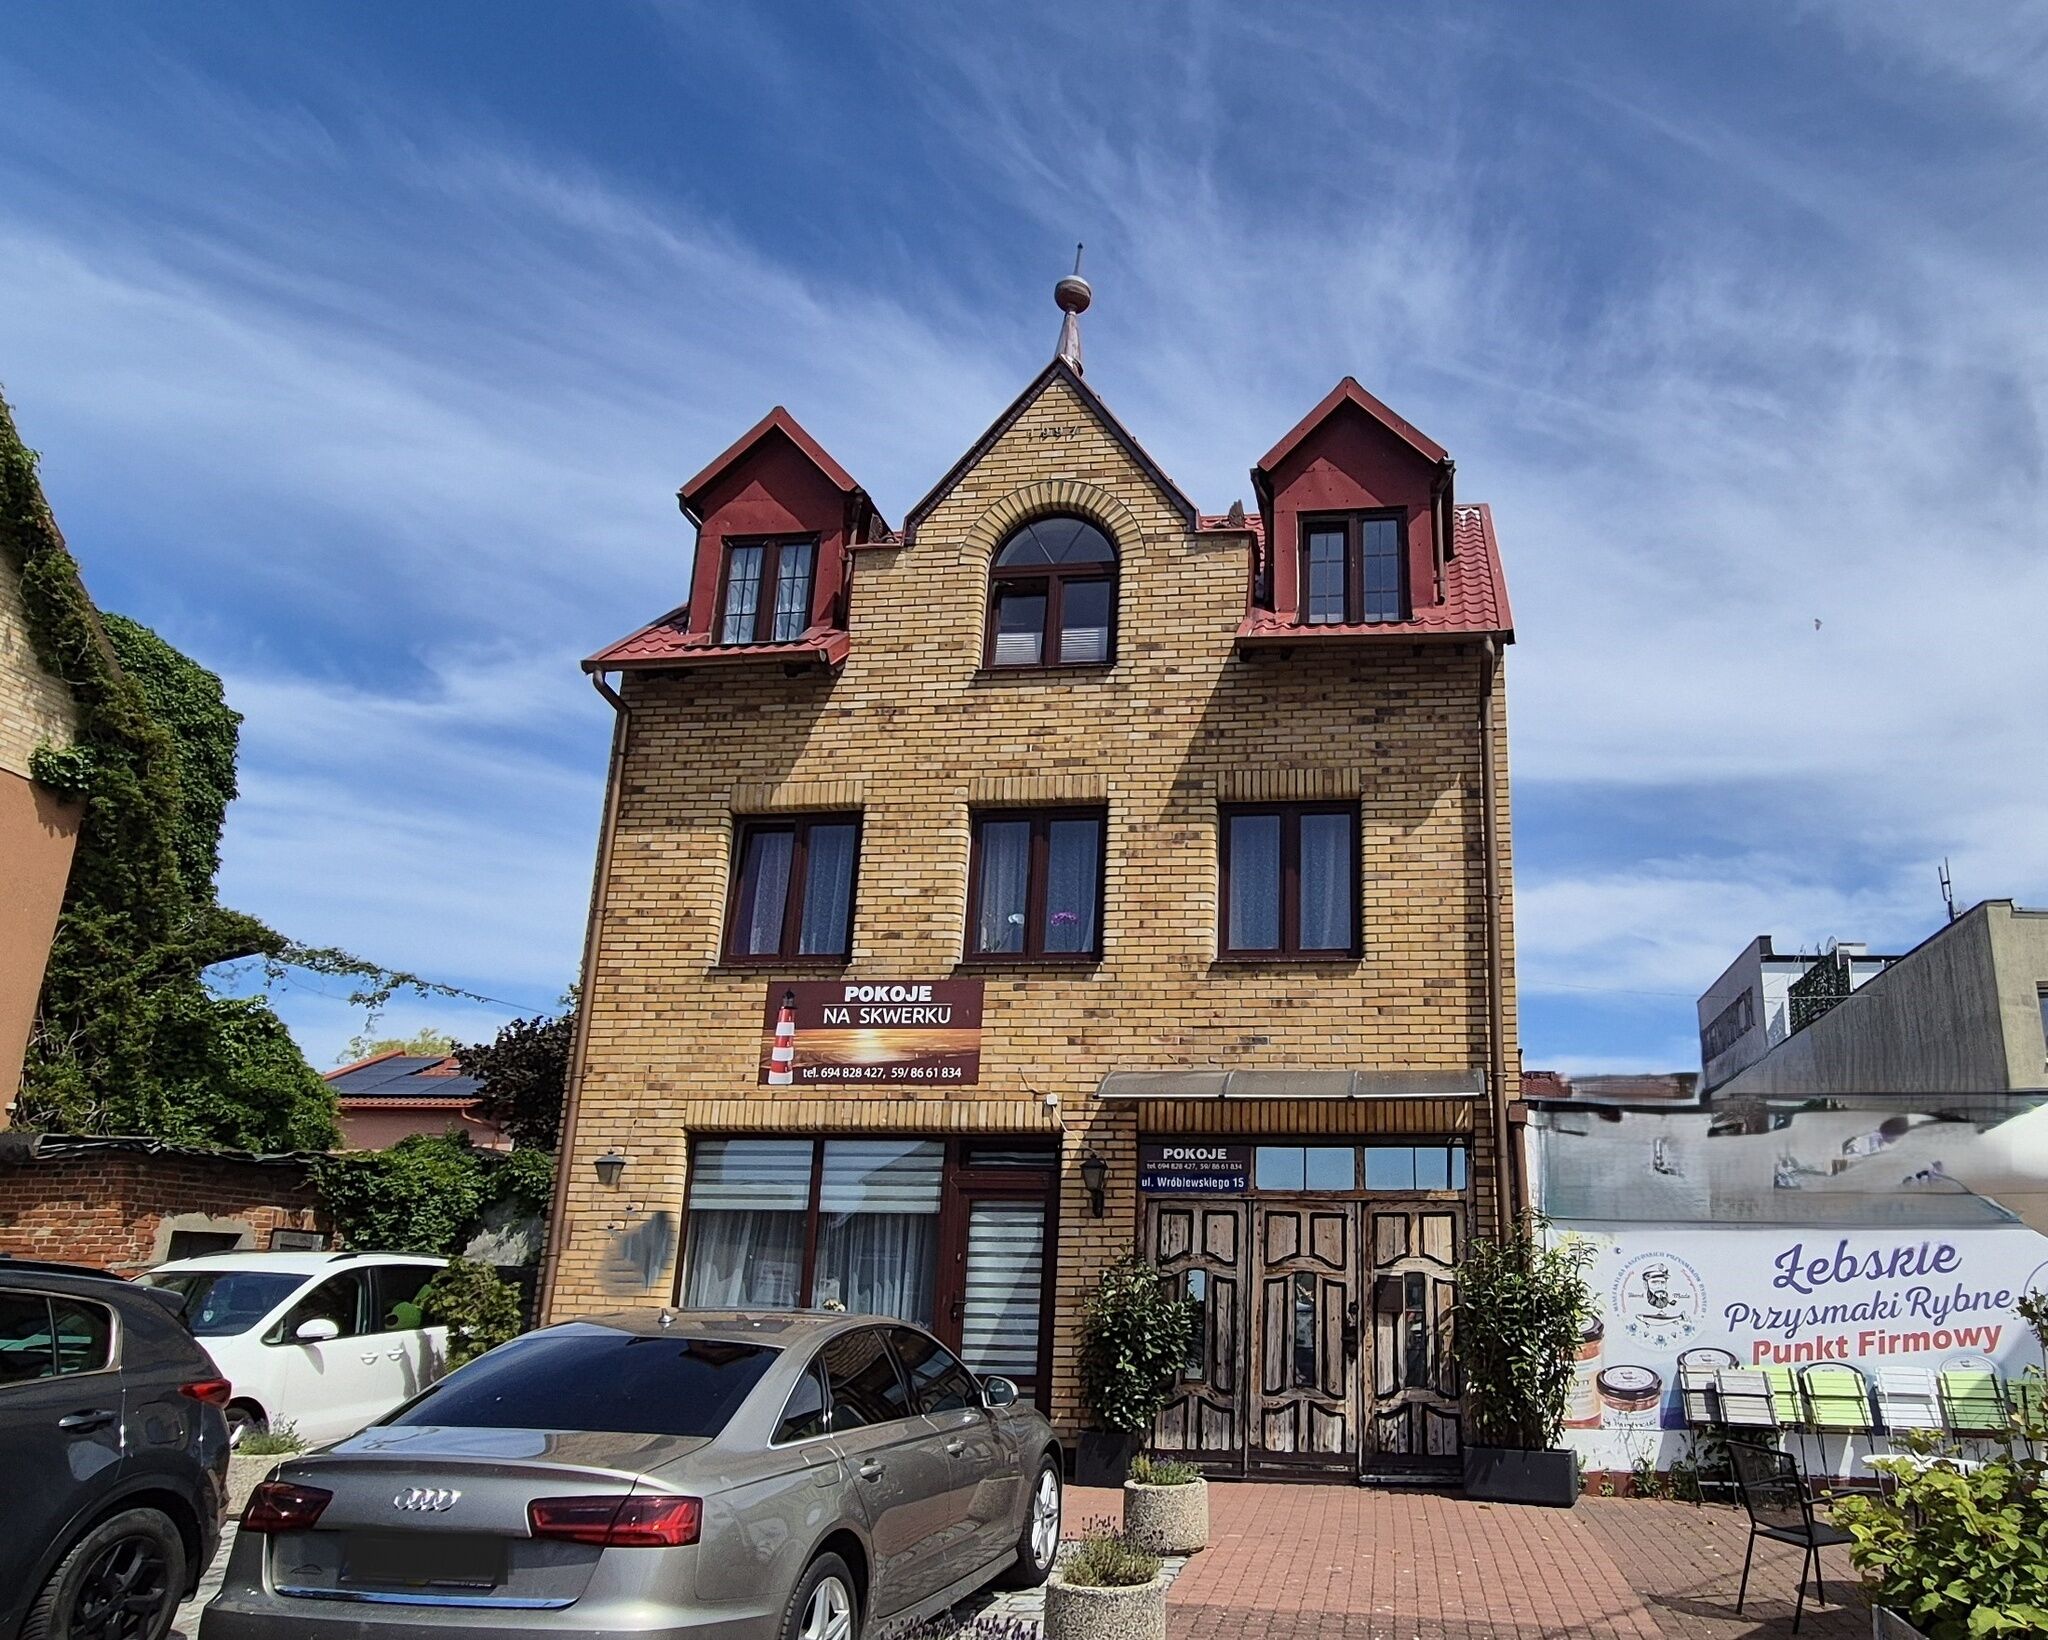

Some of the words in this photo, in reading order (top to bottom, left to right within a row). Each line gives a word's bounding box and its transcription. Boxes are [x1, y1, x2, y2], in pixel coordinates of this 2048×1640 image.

[845, 986, 932, 1002] POKOJE
[823, 1007, 850, 1024] NA
[859, 1007, 951, 1024] SKWERKU
[803, 1067, 819, 1078] tel.
[821, 1067, 840, 1078] 694
[843, 1067, 862, 1078] 828
[864, 1067, 886, 1079] 427,
[891, 1067, 909, 1078] 59/
[910, 1067, 924, 1078] 86
[926, 1067, 938, 1078] 61
[941, 1067, 961, 1078] 834
[1163, 1148, 1227, 1160] POKOJE
[1141, 1177, 1154, 1187] ul.
[1157, 1176, 1230, 1190] Wróblewskiego
[1233, 1177, 1244, 1188] 15
[1724, 1290, 1903, 1339] Przysmaki
[1905, 1283, 2014, 1326] Rybne
[1752, 1335, 1849, 1366] Punkt
[1858, 1325, 2002, 1357] Firmowy
